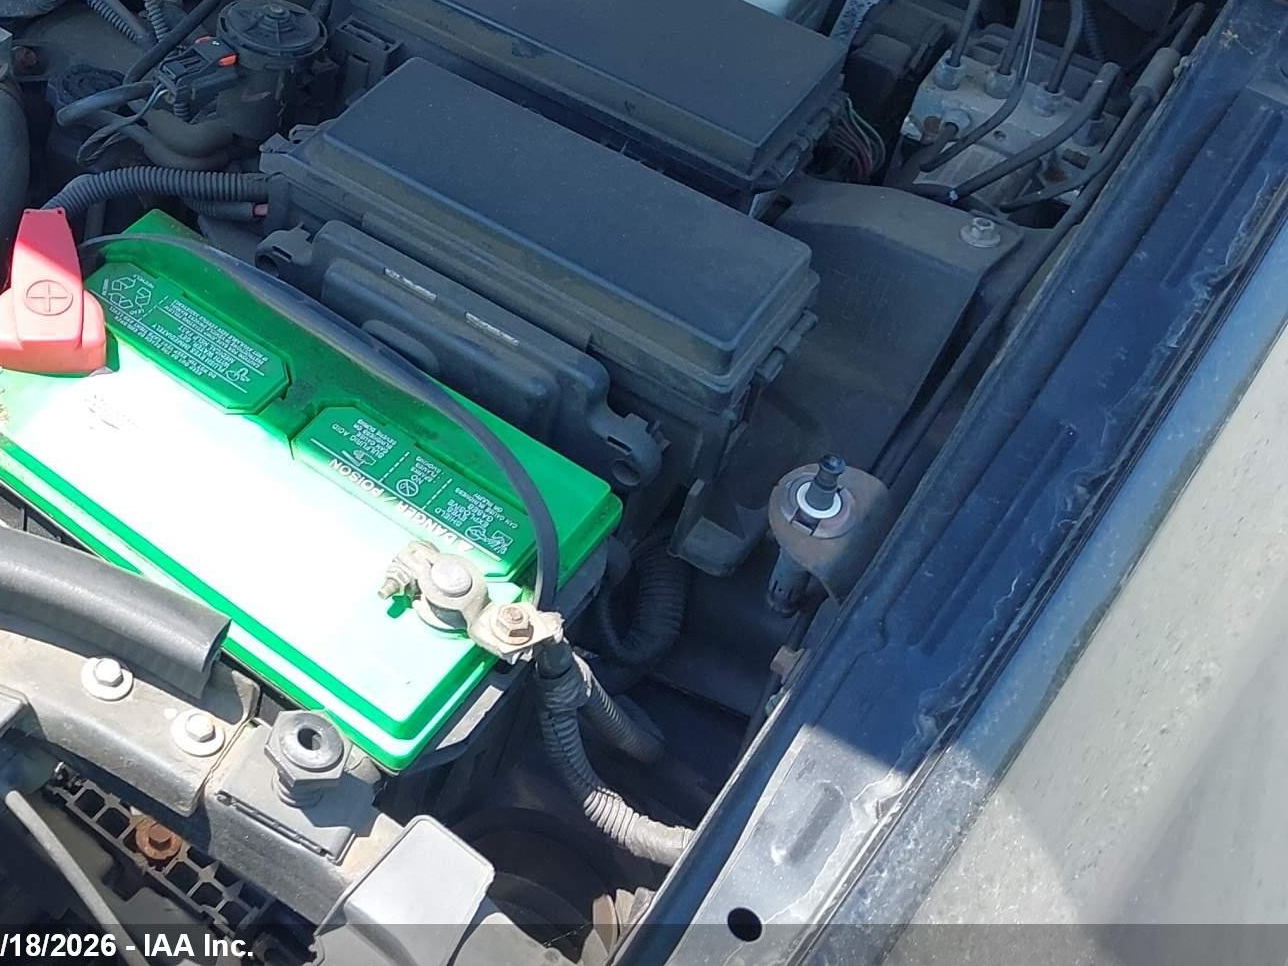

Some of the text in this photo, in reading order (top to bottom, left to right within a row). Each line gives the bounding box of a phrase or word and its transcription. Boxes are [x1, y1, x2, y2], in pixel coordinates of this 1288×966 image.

[150, 322, 226, 373] FLUSH EYES IMMEDIATELY
[176, 324, 235, 364] MEDICAL HELP FAST
[177, 332, 192, 342] GET
[212, 355, 231, 368] WITH
[330, 422, 385, 459] SULFURIC ACID
[354, 431, 389, 454] CAN CAUSE
[326, 457, 385, 497] POISON
[408, 472, 425, 484] NO
[392, 499, 459, 545] DANGER
[432, 506, 463, 527] SHIELD
[444, 505, 468, 521] EYES
[445, 498, 490, 528] EXPLOSIVE
[465, 502, 495, 523] GASES
